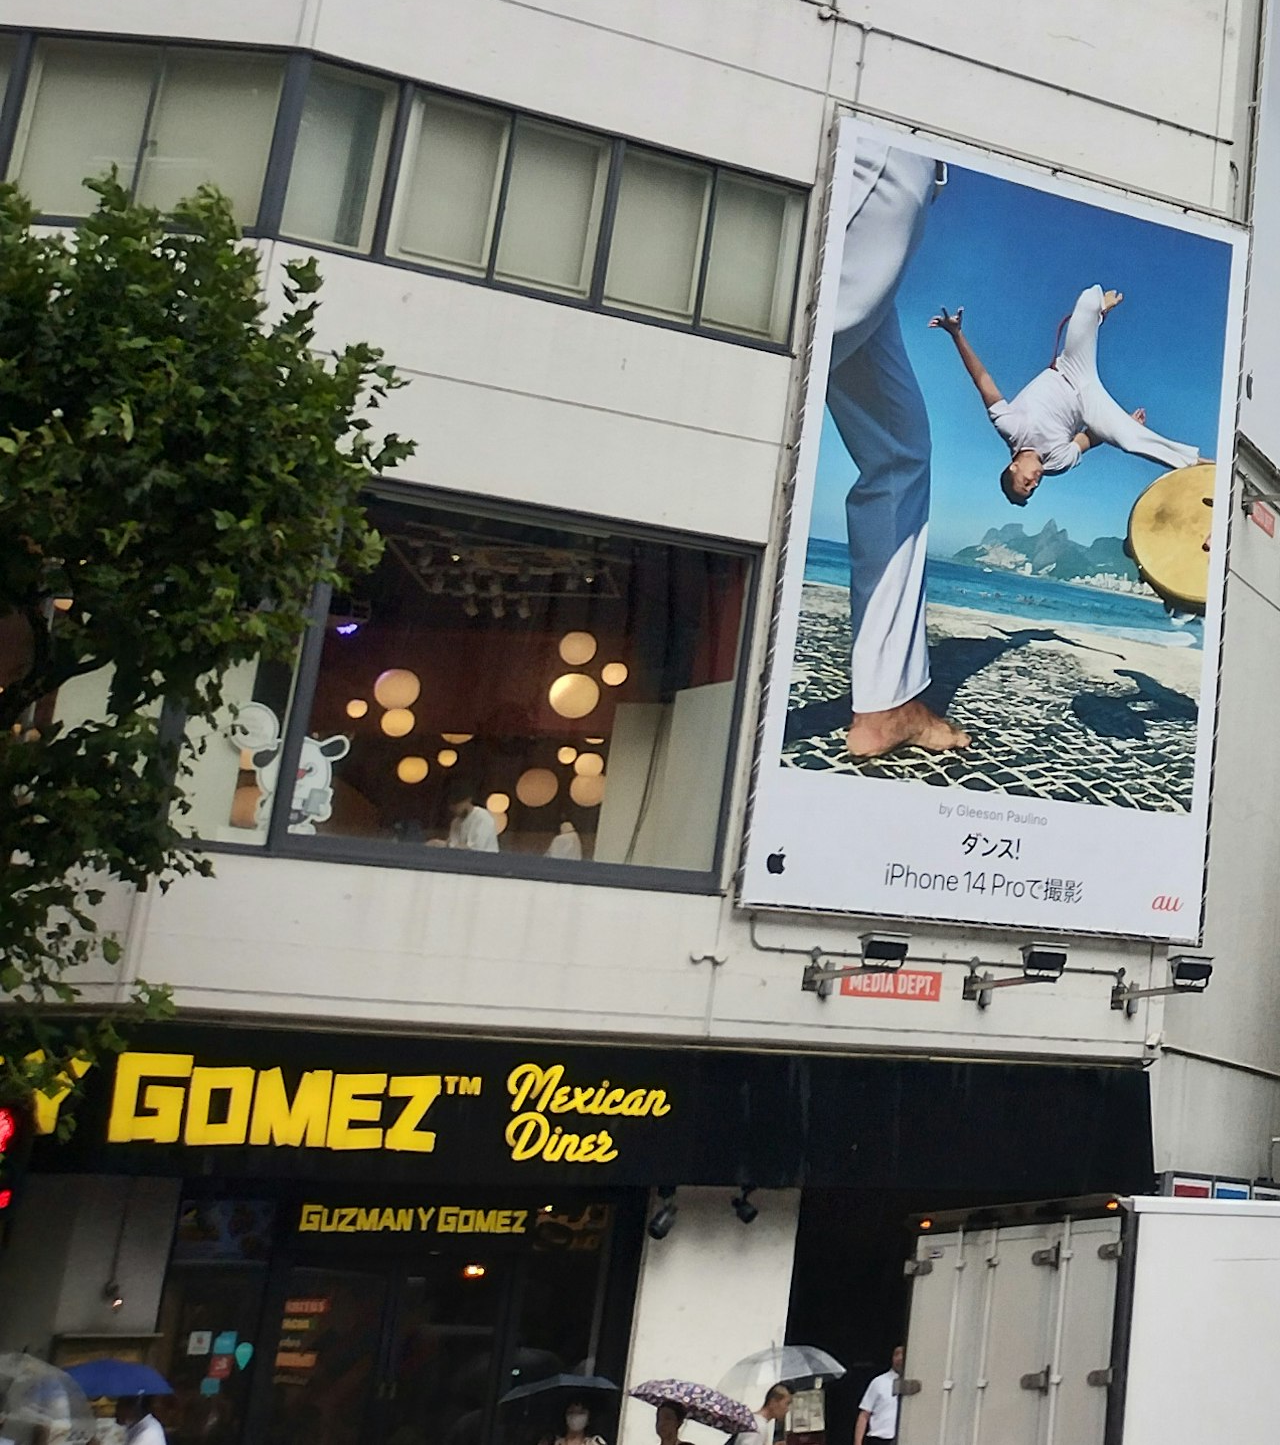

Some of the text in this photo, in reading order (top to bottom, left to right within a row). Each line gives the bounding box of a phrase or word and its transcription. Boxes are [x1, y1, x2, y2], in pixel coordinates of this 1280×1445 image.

[938, 803, 1048, 827] by Gleeson Paulino
[961, 833, 1021, 861] ダンス!
[884, 862, 959, 893] iPhone
[965, 871, 986, 896] 14
[1151, 894, 1184, 914] au
[848, 972, 895, 995] MEDIA
[506, 1062, 672, 1118] Mexican
[504, 1110, 619, 1163] Diner
[299, 1203, 415, 1233] GUZMAN
[417, 1206, 436, 1232] Y
[436, 1205, 529, 1234] GOMEZ
